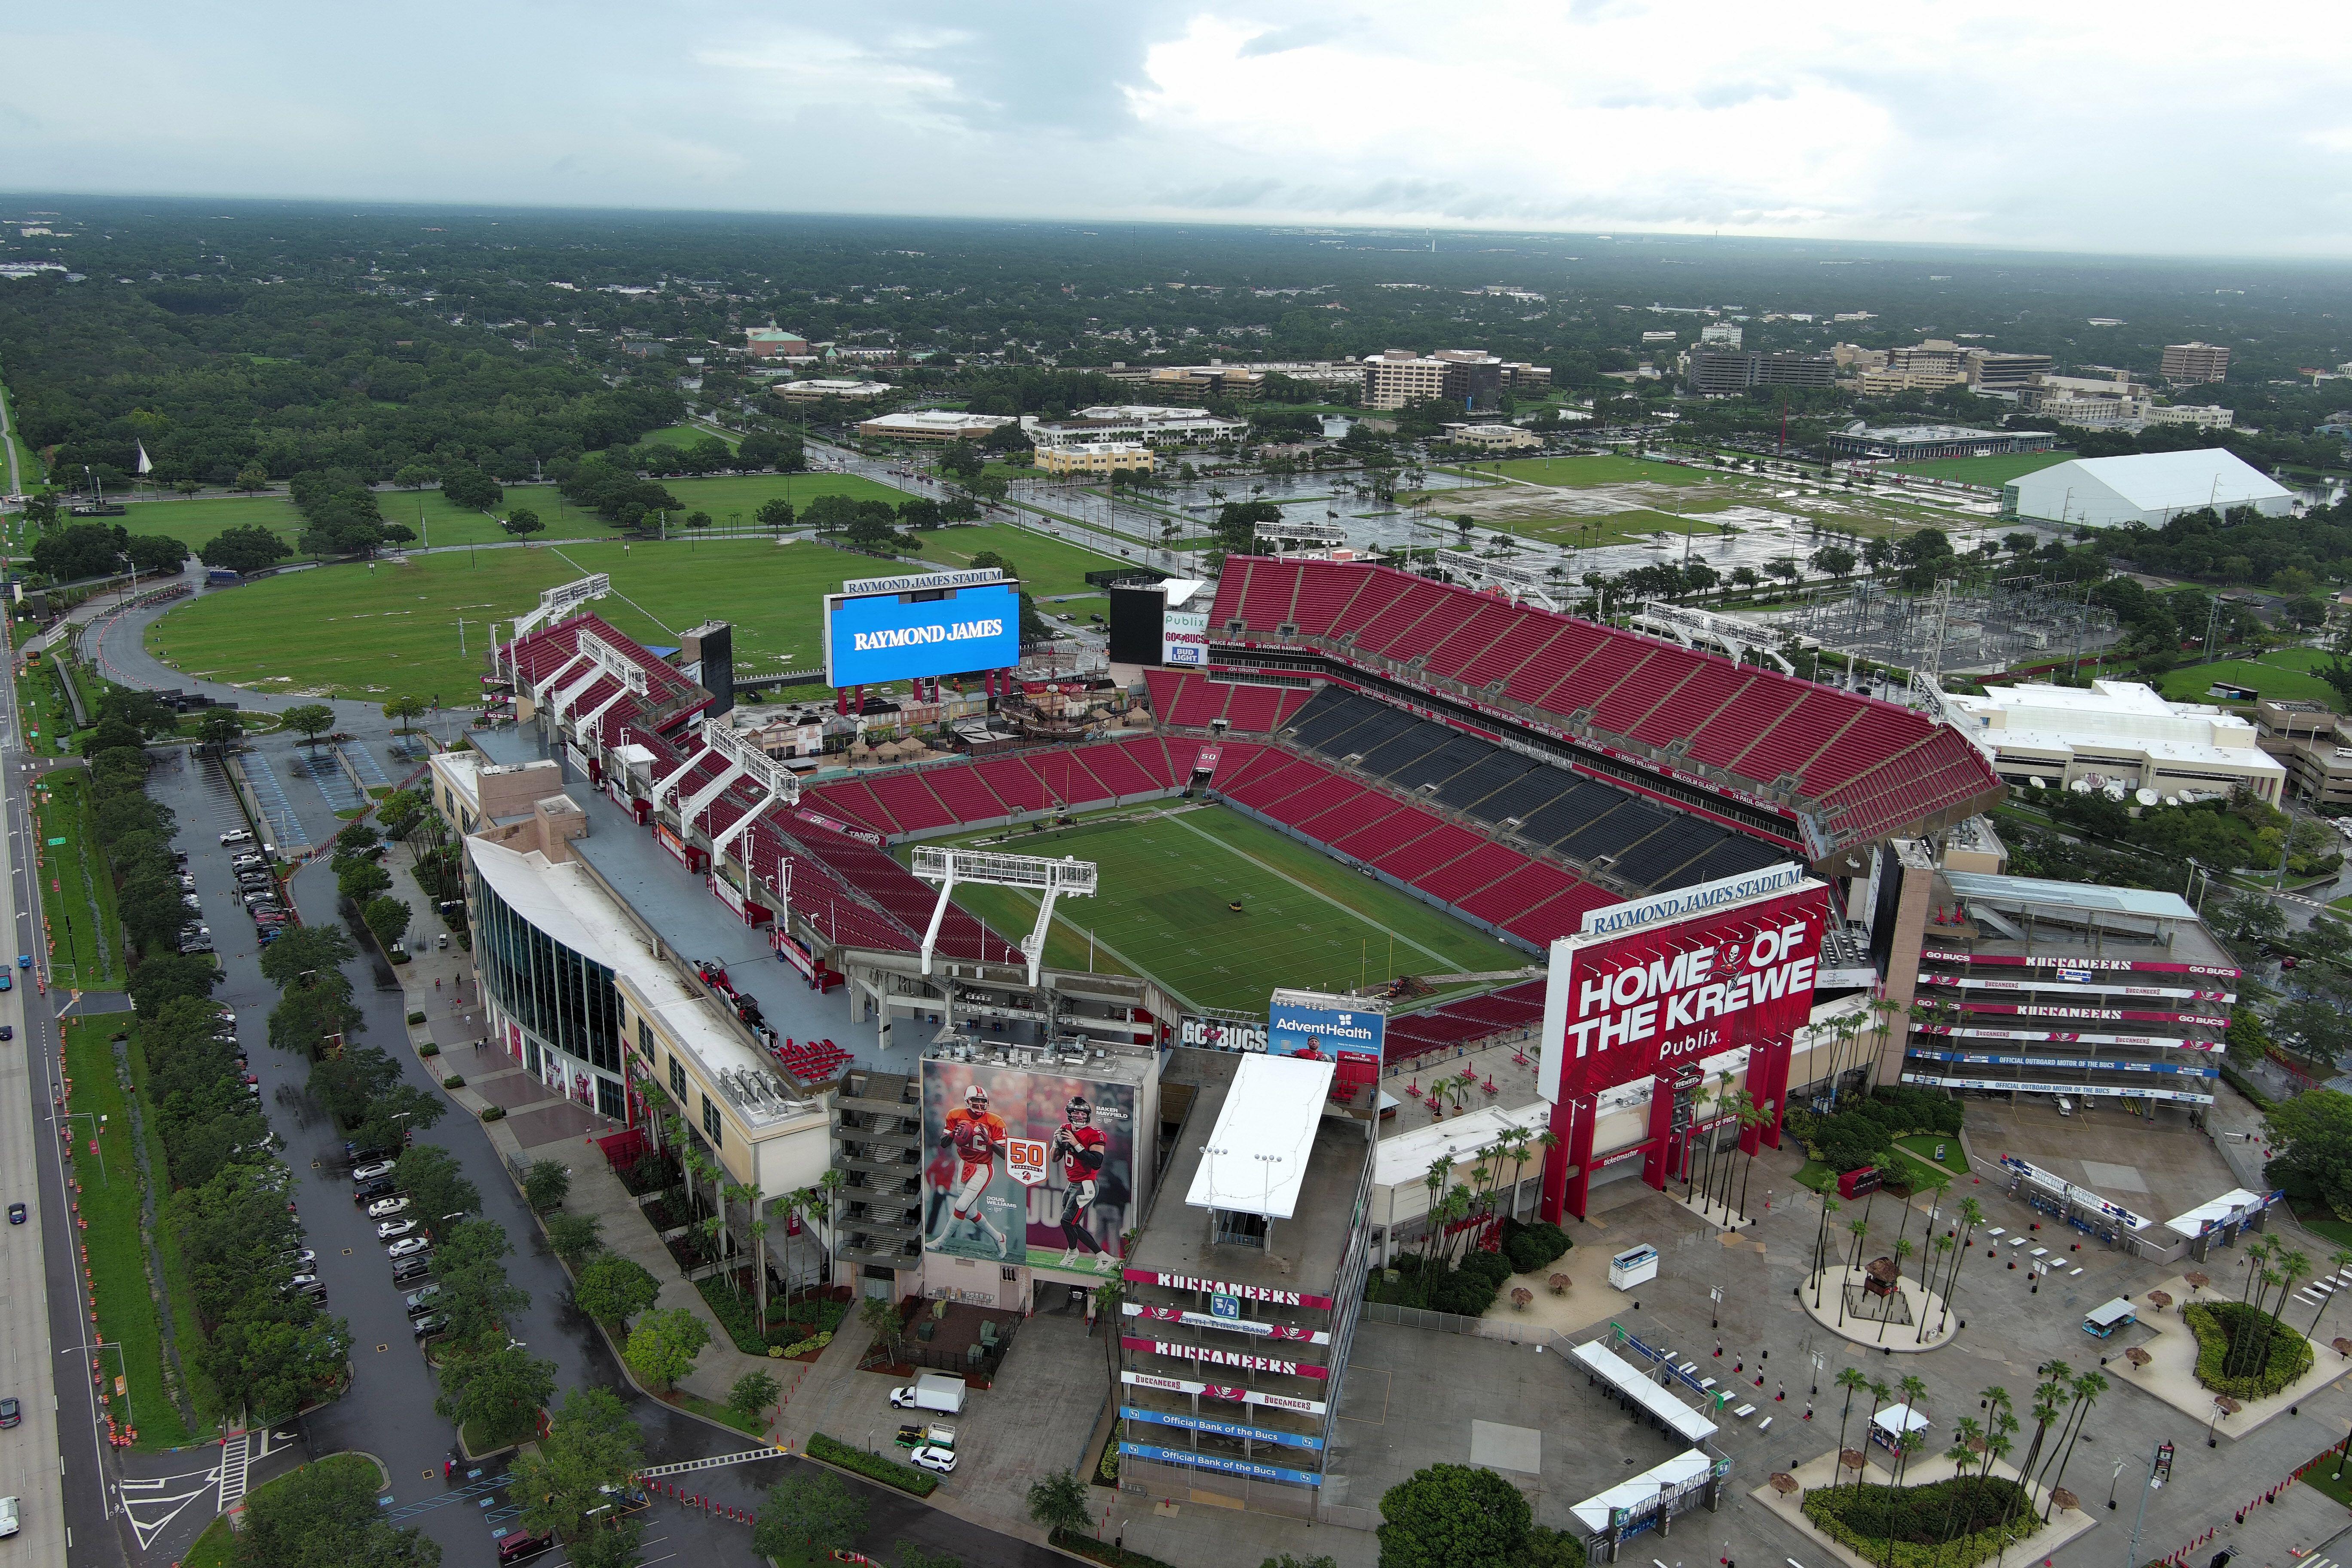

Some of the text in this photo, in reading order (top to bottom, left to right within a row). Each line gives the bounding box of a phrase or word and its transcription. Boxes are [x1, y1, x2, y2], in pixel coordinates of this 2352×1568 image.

[848, 570, 1002, 593] RAYMOND JAMES STADIUM
[1165, 615, 1204, 627] Publix
[854, 619, 1002, 650] RAYMOND JAMES
[1165, 632, 1176, 642] GO
[1333, 655, 1344, 664] LYNCH
[1366, 666, 1381, 676] ALSTOTT
[1395, 676, 1410, 686] DERRICK
[1411, 682, 1427, 692] BROOKS
[1360, 687, 1408, 708] SUPER BOWL CHAMPIONS
[1441, 692, 1458, 702] WARREN
[1501, 714, 1519, 724] SELMON
[1534, 725, 1550, 735] JIMMIE
[1550, 730, 1563, 739] GILES
[1501, 738, 1571, 769] RAYMOND JAMES STADIUM
[1574, 739, 1604, 753] JOHN MCKAY
[1621, 754, 1635, 763] DOUG
[1636, 759, 1660, 772] WILLIAMS
[1672, 772, 1719, 793] MALCOLM GLAZER
[1740, 795, 1754, 805] PAUL
[1755, 800, 1778, 814] GRUBER
[809, 815, 825, 824] 50
[848, 831, 880, 840] TAMPA
[720, 878, 729, 891] TACO
[1592, 868, 1801, 935] RAYMOND JAMES STADIUM
[1943, 953, 1970, 962] BUCS
[2025, 957, 2132, 971] BUCCANEERS
[1578, 922, 1806, 1018] HOME OF
[2206, 967, 2236, 977] BUCS
[2125, 987, 2160, 995] BUCCANEERS
[1568, 956, 1816, 1059] THE KREWE
[2017, 1005, 2122, 1020] BUCCANEERS
[1276, 1018, 1372, 1040] AdventHealth
[2196, 1017, 2225, 1026] BUCS
[1181, 1021, 1268, 1051] GO BUCS
[1659, 1029, 1719, 1060] Publix
[1675, 1076, 1700, 1088] TICKETS
[2021, 1083, 2051, 1091] OUTBOARD
[1011, 1142, 1043, 1167] 50
[1604, 1149, 1638, 1166] ticketmaster
[2034, 1169, 2101, 1208] SUZUKI MARINE
[986, 1200, 1017, 1208] WILLIAMS
[1158, 1272, 1299, 1305] BUCCANEERS
[1180, 1315, 1269, 1335] FIFTH THIRD BANK
[1155, 1341, 1296, 1375] BUCCANEERS
[1136, 1375, 1180, 1390] BUCCANEERS
[1265, 1395, 1311, 1411] BUCCANEERS
[1163, 1415, 1278, 1441] Official Bank of the Bucs
[1162, 1451, 1276, 1476] Official Bank of the Bucs
[1635, 1467, 1711, 1518] FIFTH THIRD BANK
